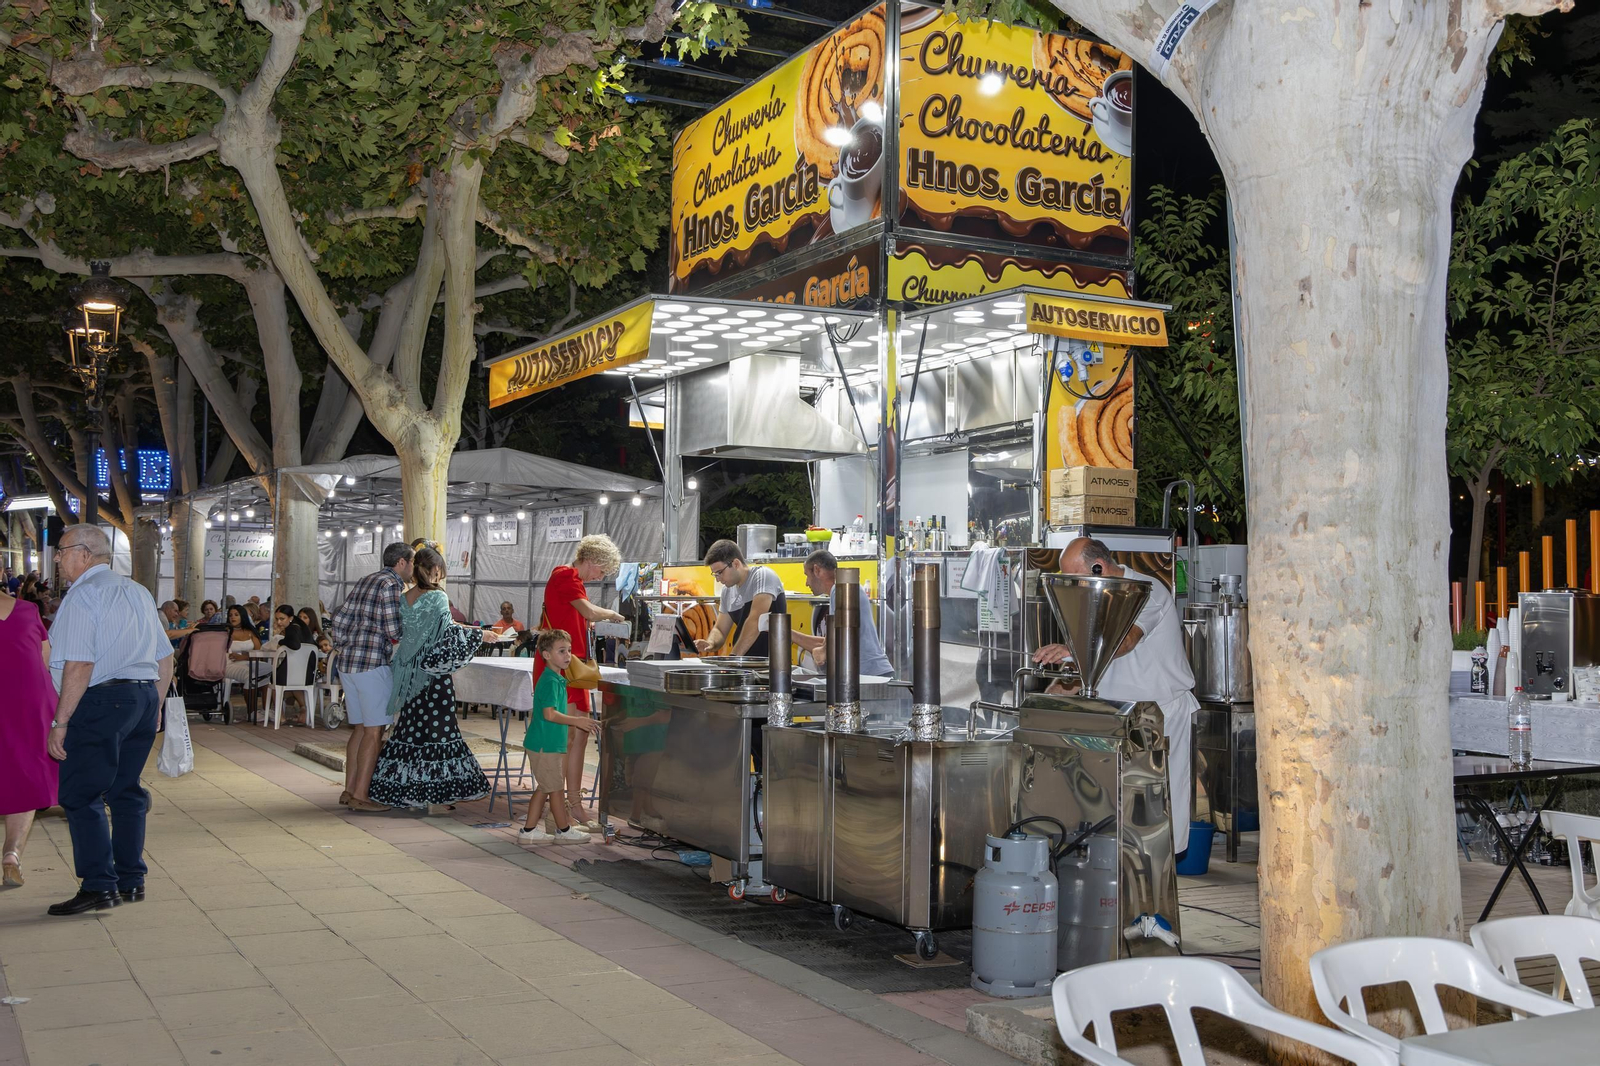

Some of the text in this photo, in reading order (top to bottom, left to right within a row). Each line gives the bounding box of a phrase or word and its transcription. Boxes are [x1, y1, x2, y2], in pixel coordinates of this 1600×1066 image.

[919, 31, 1079, 96] Churrería
[713, 84, 786, 156] Churrería
[918, 93, 1113, 163] Chocolatería
[693, 132, 782, 208] Chocolatería
[907, 147, 1123, 220] Hnos. García
[682, 152, 821, 261] Hnos. García
[803, 254, 870, 308] García
[1031, 302, 1161, 336] AUTOSERVICIO
[507, 320, 626, 394] AUTOSERVICIO
[1089, 506, 1129, 516] ATMOSS
[1090, 477, 1130, 487] ATMOSS
[1022, 900, 1055, 913] CEPSA
